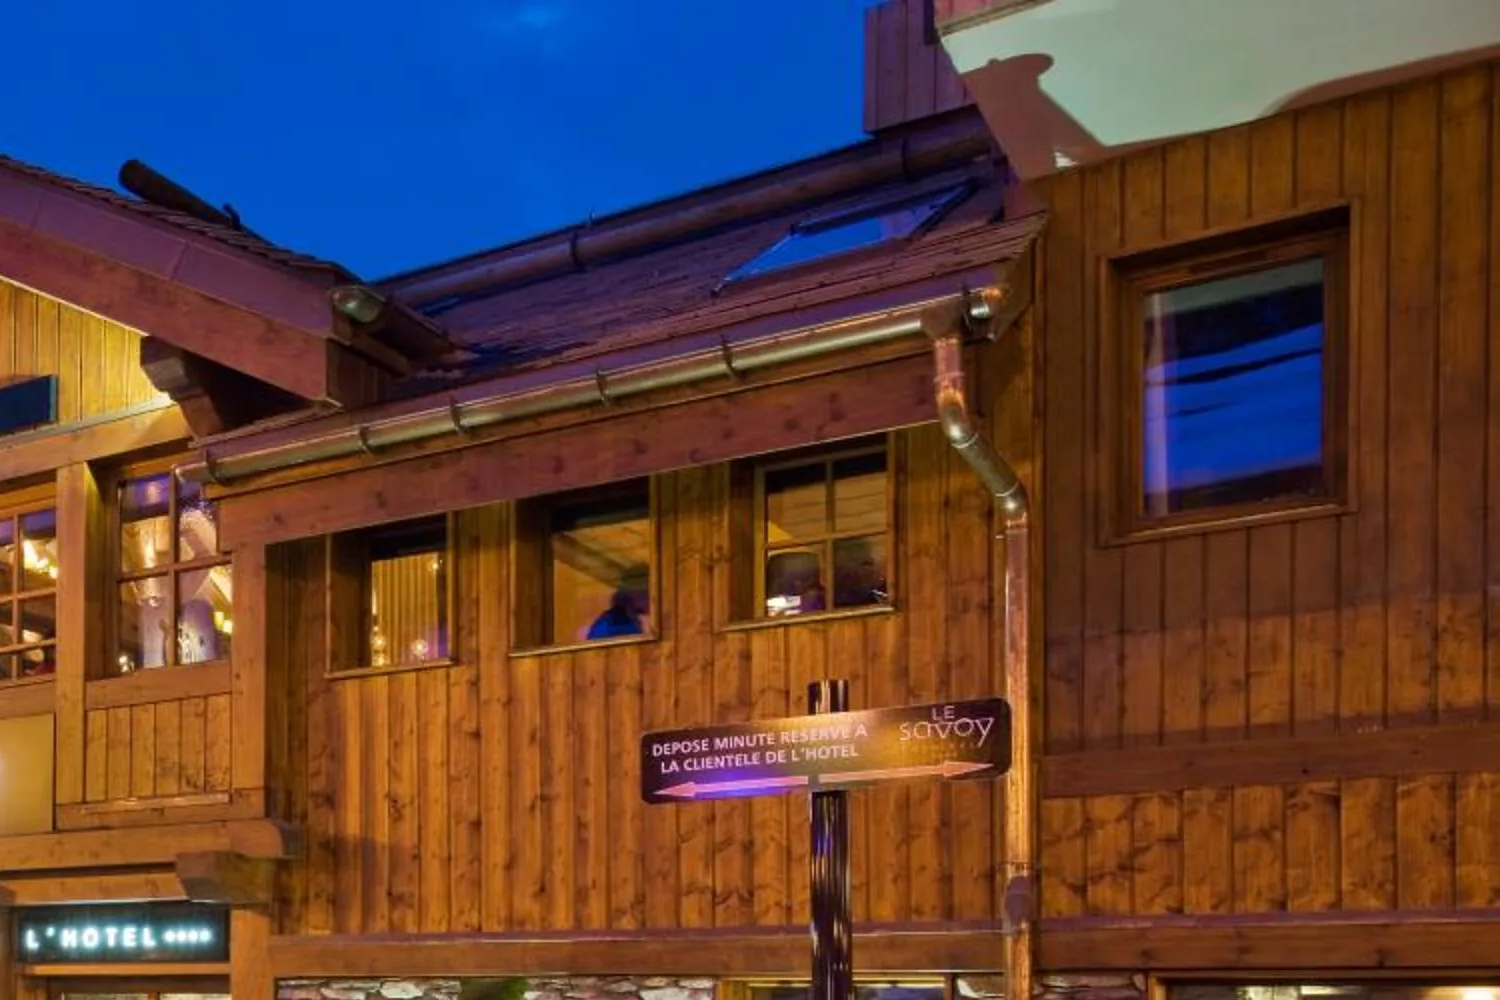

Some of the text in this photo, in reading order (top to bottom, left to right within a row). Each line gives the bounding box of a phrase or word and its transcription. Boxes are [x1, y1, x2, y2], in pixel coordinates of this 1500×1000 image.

[931, 705, 956, 720] LE
[652, 738, 709, 757] DEPOSE
[714, 732, 775, 751] MINUTE
[661, 760, 680, 774] LA
[683, 750, 761, 772] CLIENTELE
[765, 750, 787, 764] DE
[24, 926, 156, 950] L'HOTEL
